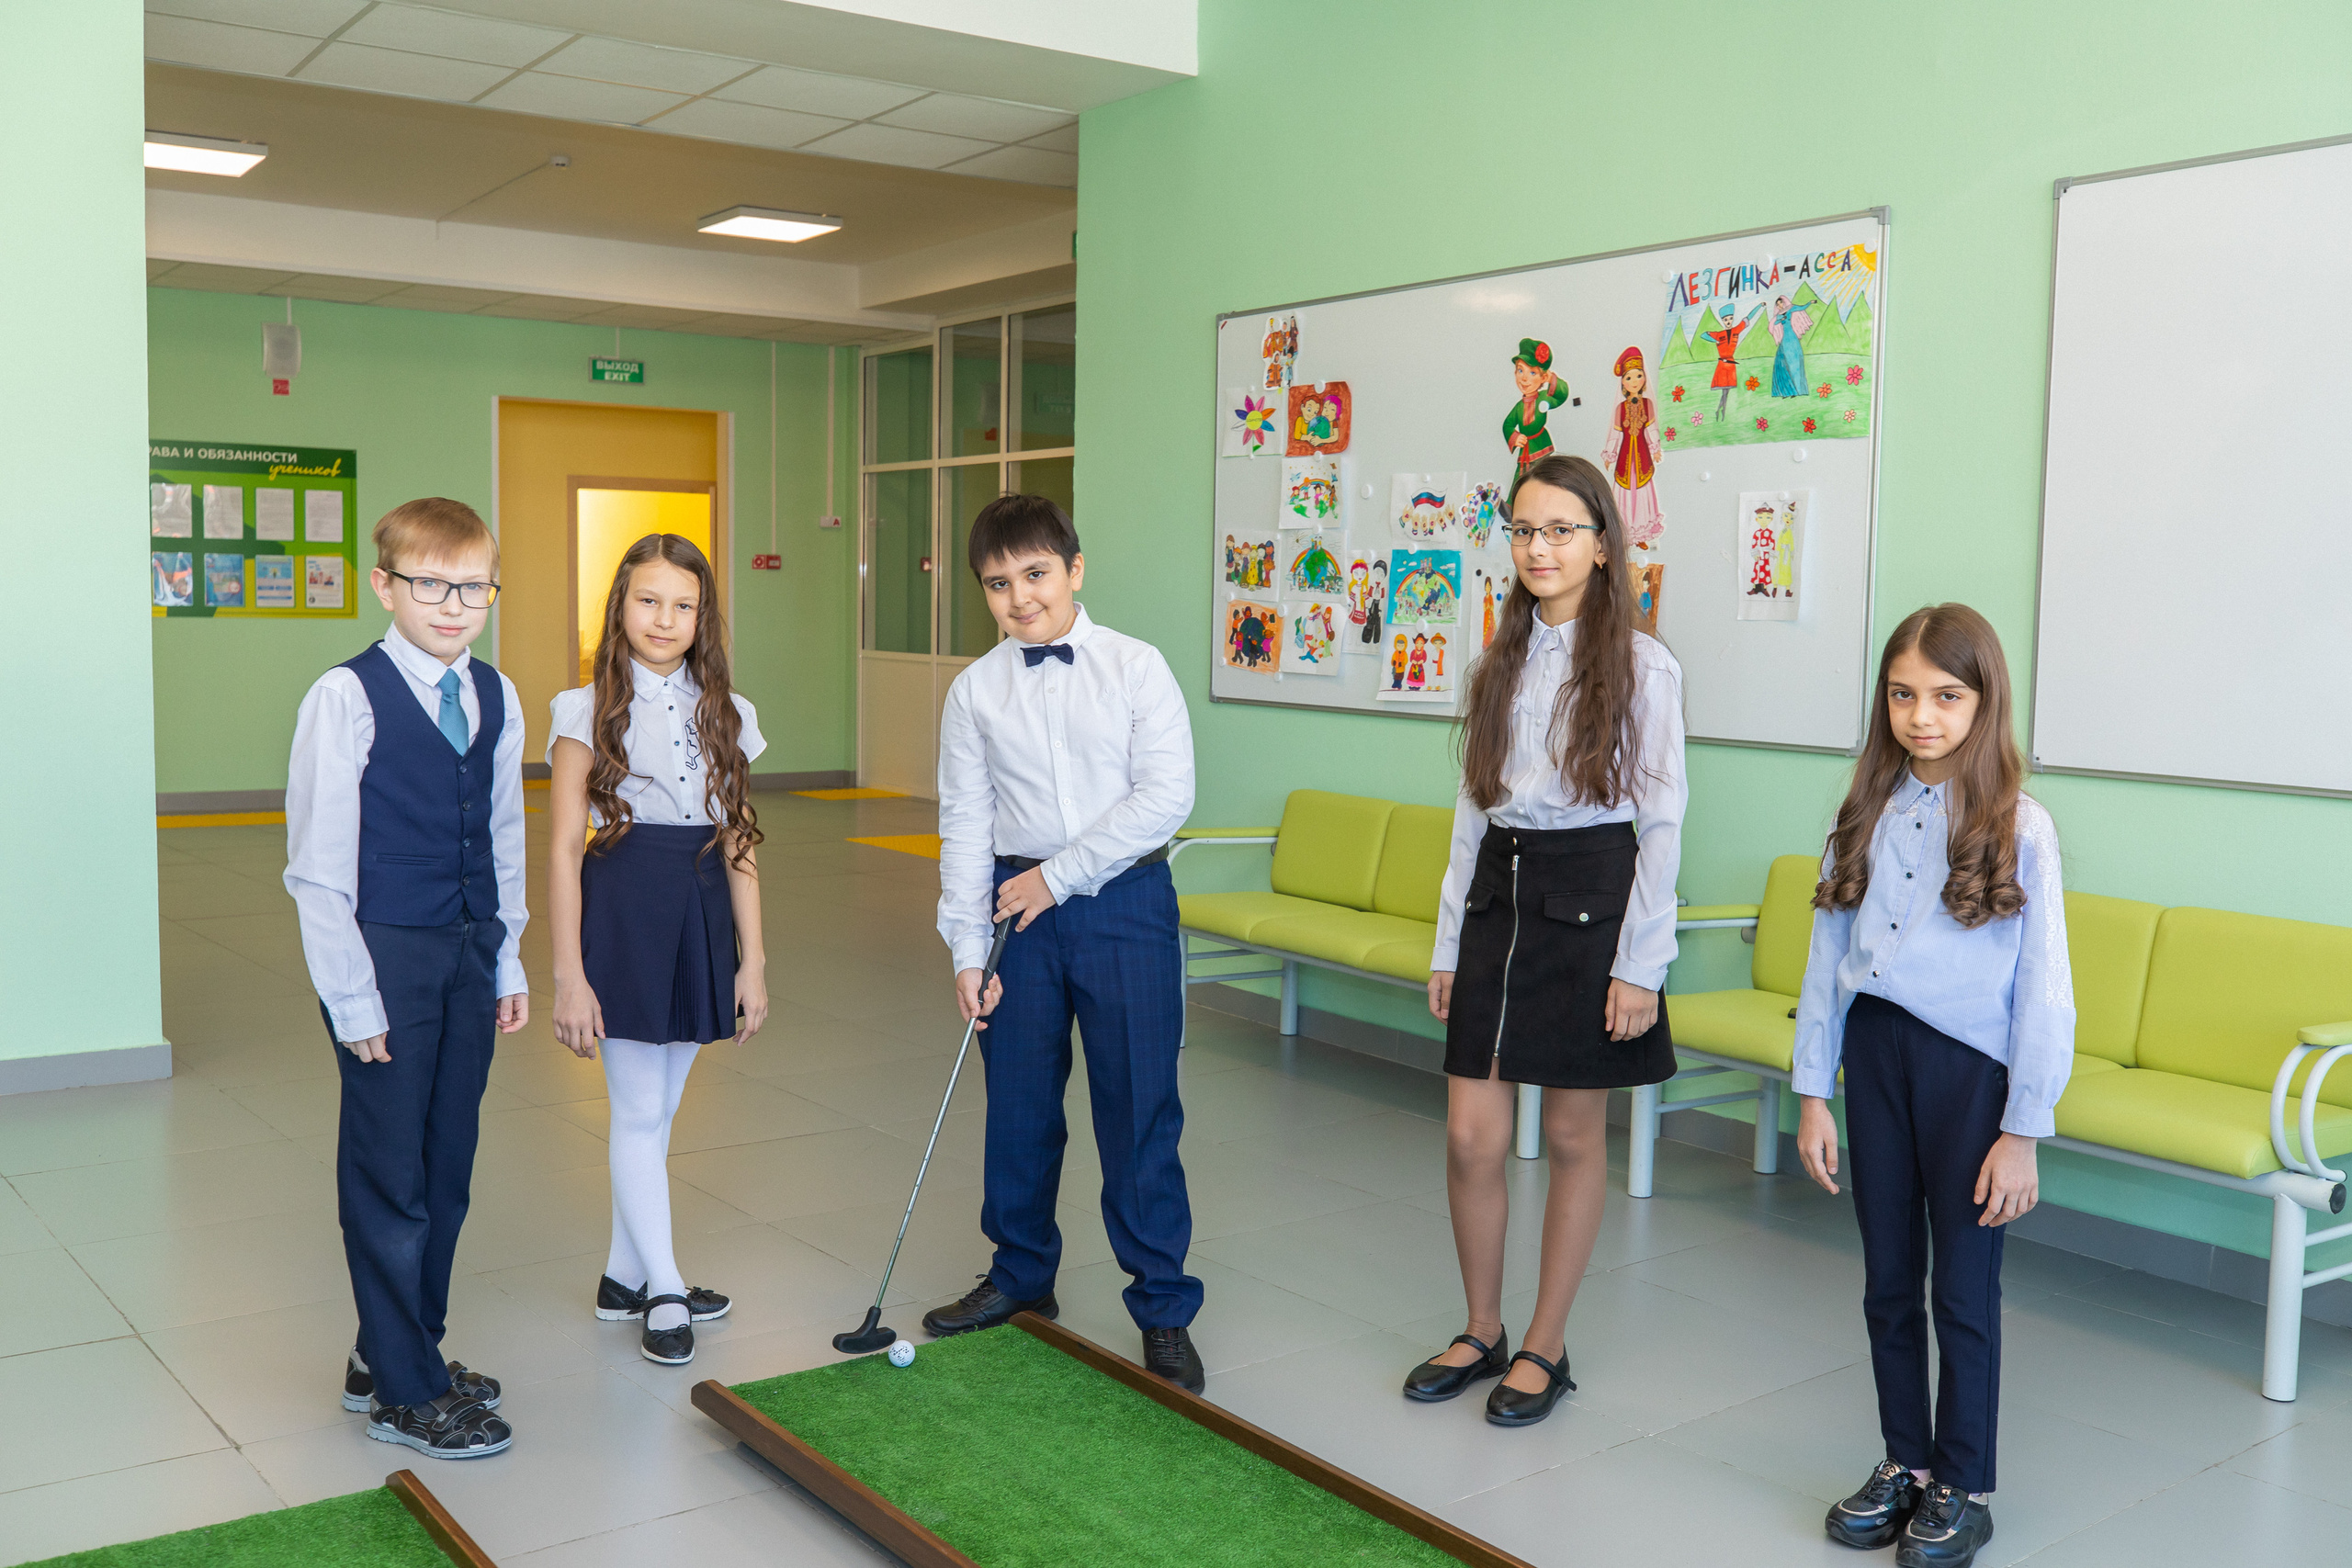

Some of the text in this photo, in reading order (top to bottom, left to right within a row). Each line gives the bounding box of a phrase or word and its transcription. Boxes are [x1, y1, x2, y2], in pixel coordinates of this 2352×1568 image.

[596, 360, 639, 374] ВЫХОД
[605, 370, 630, 381] EXIT
[184, 447, 194, 458] И
[198, 448, 298, 463] ОБЯЗАННОСТИ
[268, 457, 342, 481] учеников
